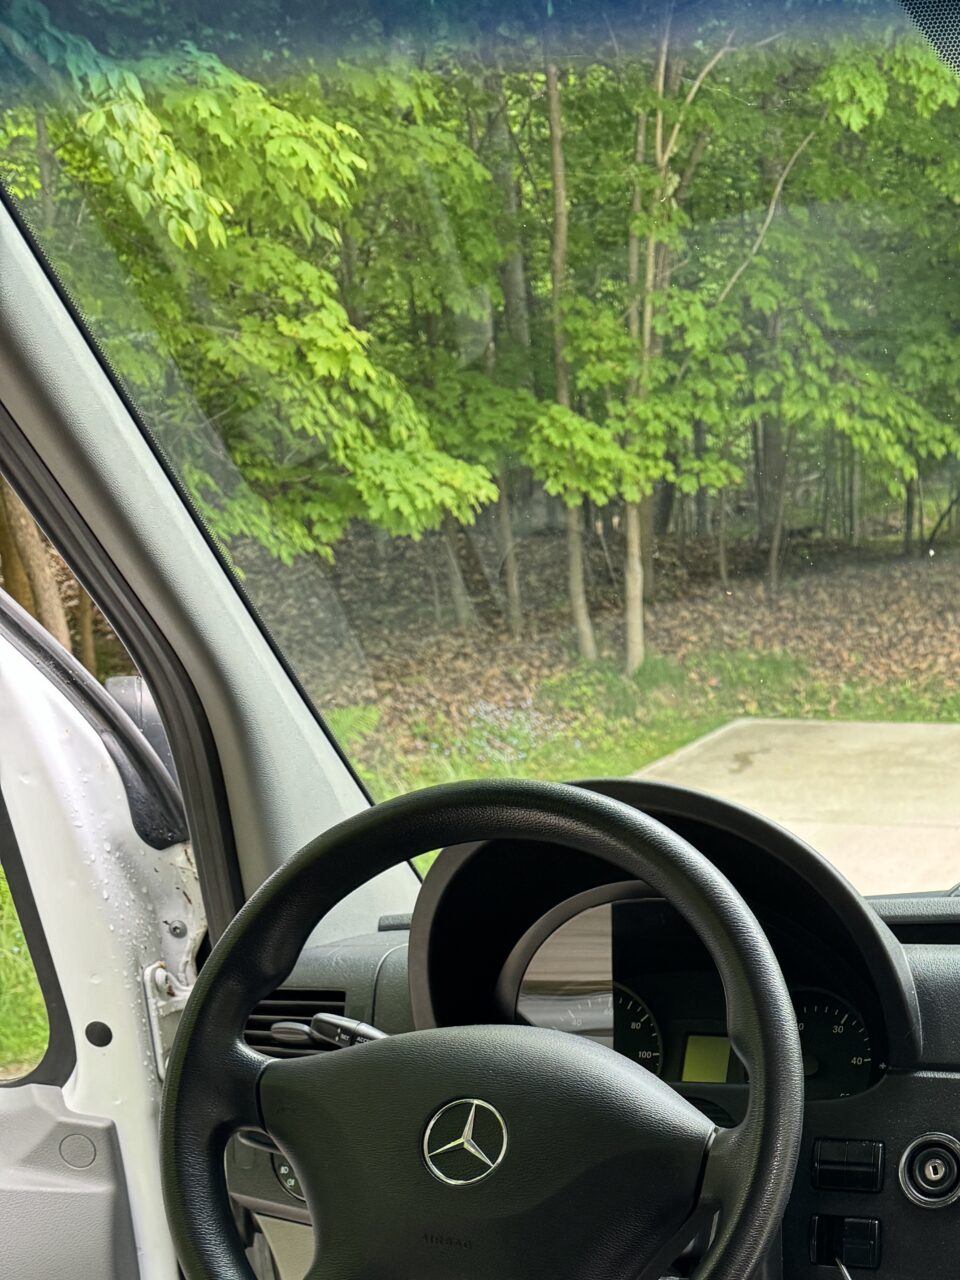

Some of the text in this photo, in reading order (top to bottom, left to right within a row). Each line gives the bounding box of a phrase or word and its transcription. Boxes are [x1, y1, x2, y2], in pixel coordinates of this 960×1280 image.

[630, 1021, 641, 1030] 80
[832, 1025, 844, 1034] 30
[638, 1051, 652, 1059] 100
[850, 1056, 863, 1065] 40
